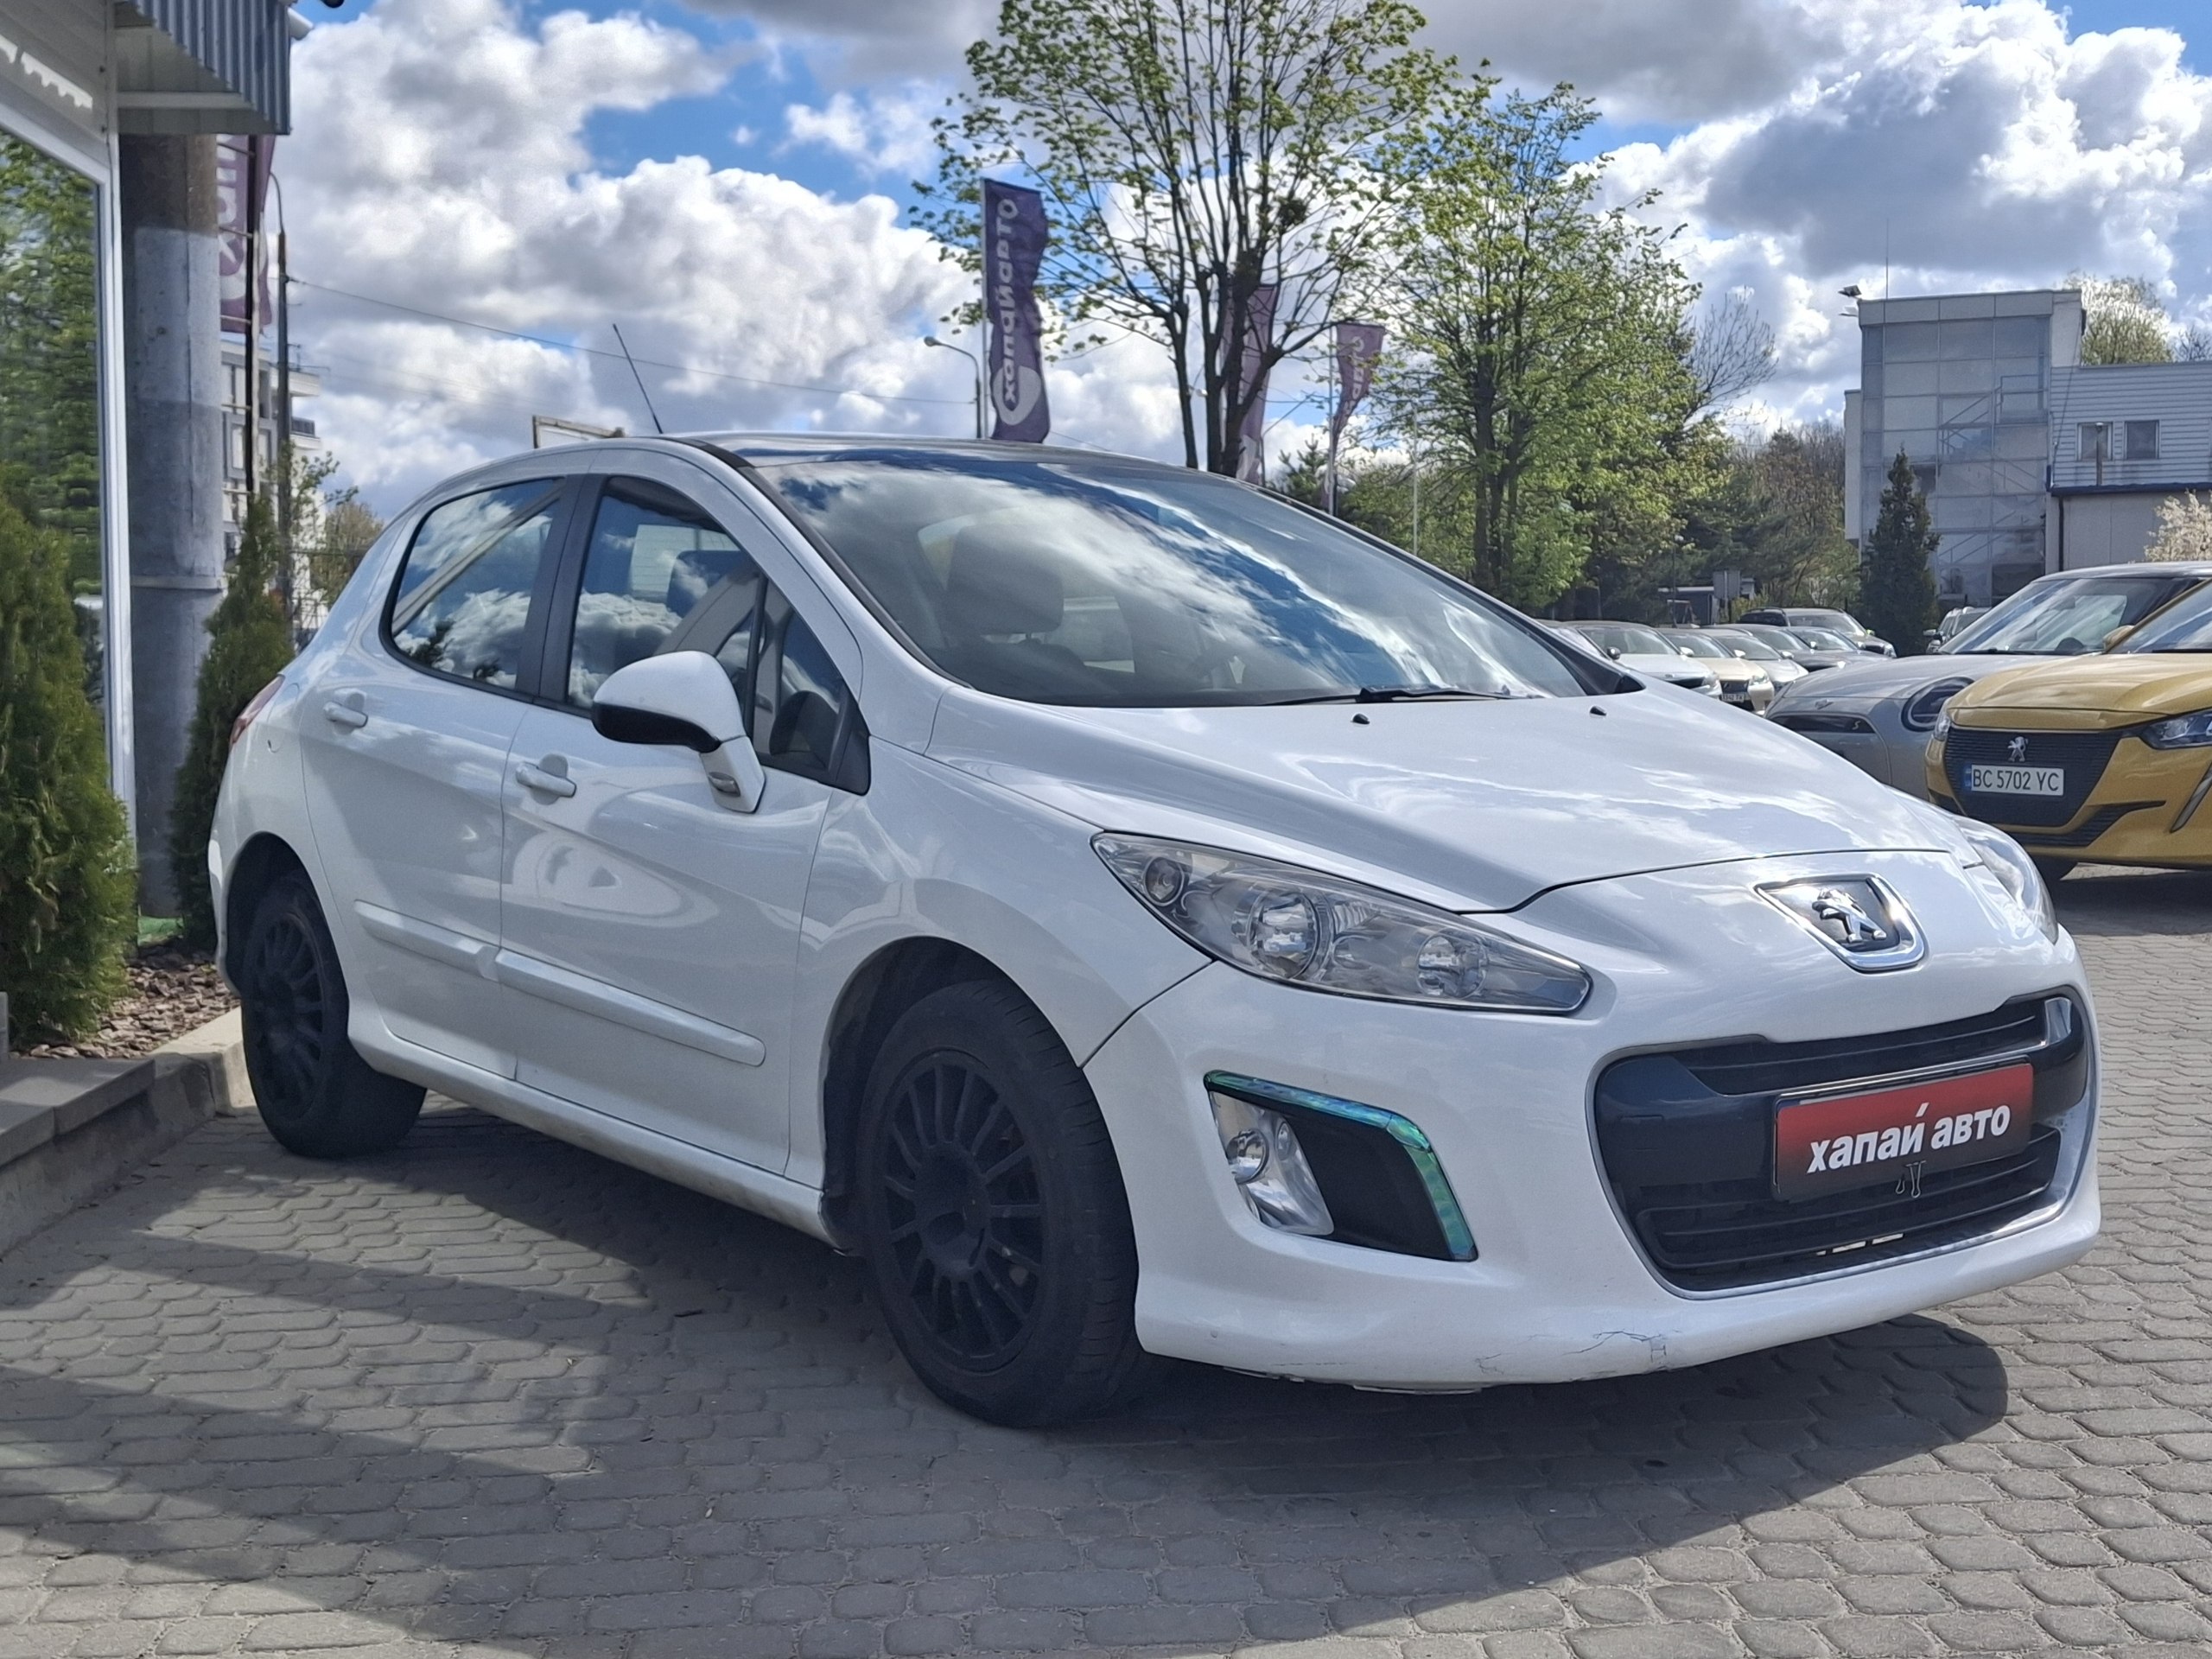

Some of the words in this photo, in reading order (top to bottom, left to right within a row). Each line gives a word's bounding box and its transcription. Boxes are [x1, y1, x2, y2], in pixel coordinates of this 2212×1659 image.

[1973, 768, 1993, 788] BC
[1996, 770, 2031, 791] 5702
[2036, 771, 2060, 791] YC
[1930, 1104, 2012, 1150] авто
